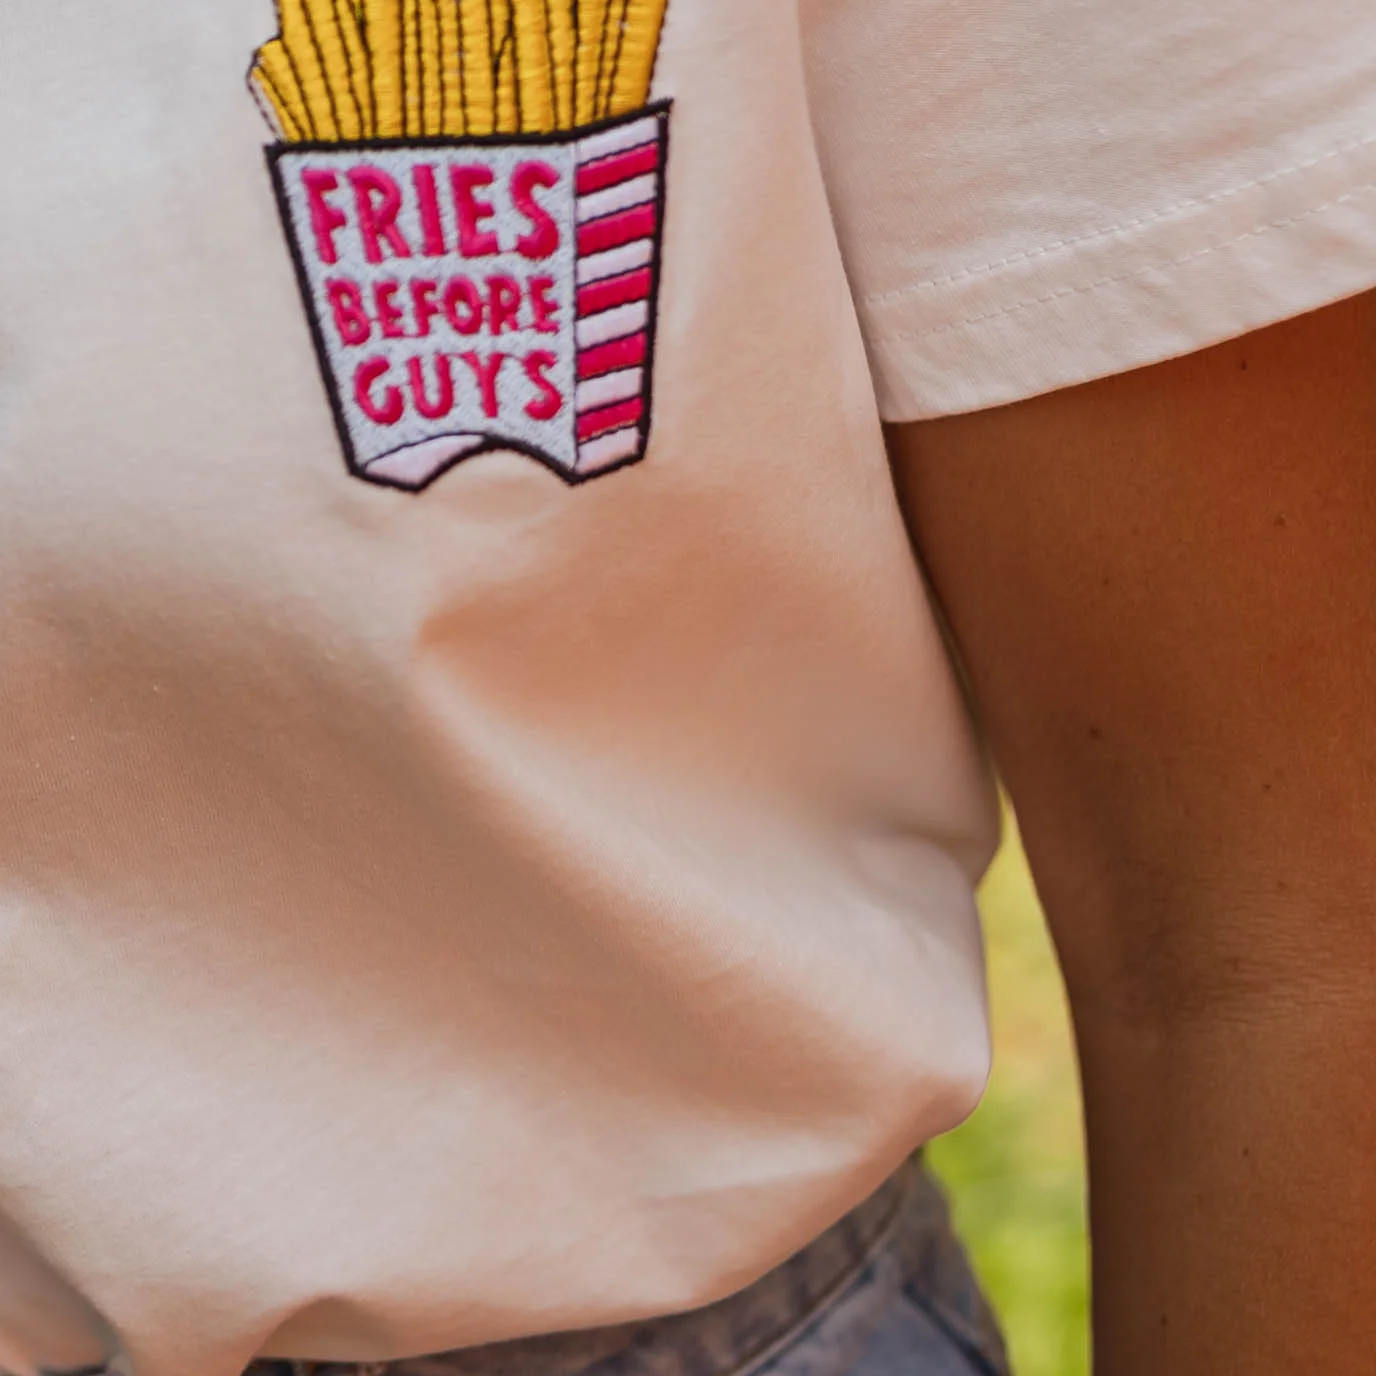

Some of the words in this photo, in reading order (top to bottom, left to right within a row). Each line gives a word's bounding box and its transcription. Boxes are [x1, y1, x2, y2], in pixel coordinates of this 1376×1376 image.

[301, 160, 560, 264] FRIES
[325, 274, 559, 347] BEFORE
[353, 349, 562, 425] GUYS
